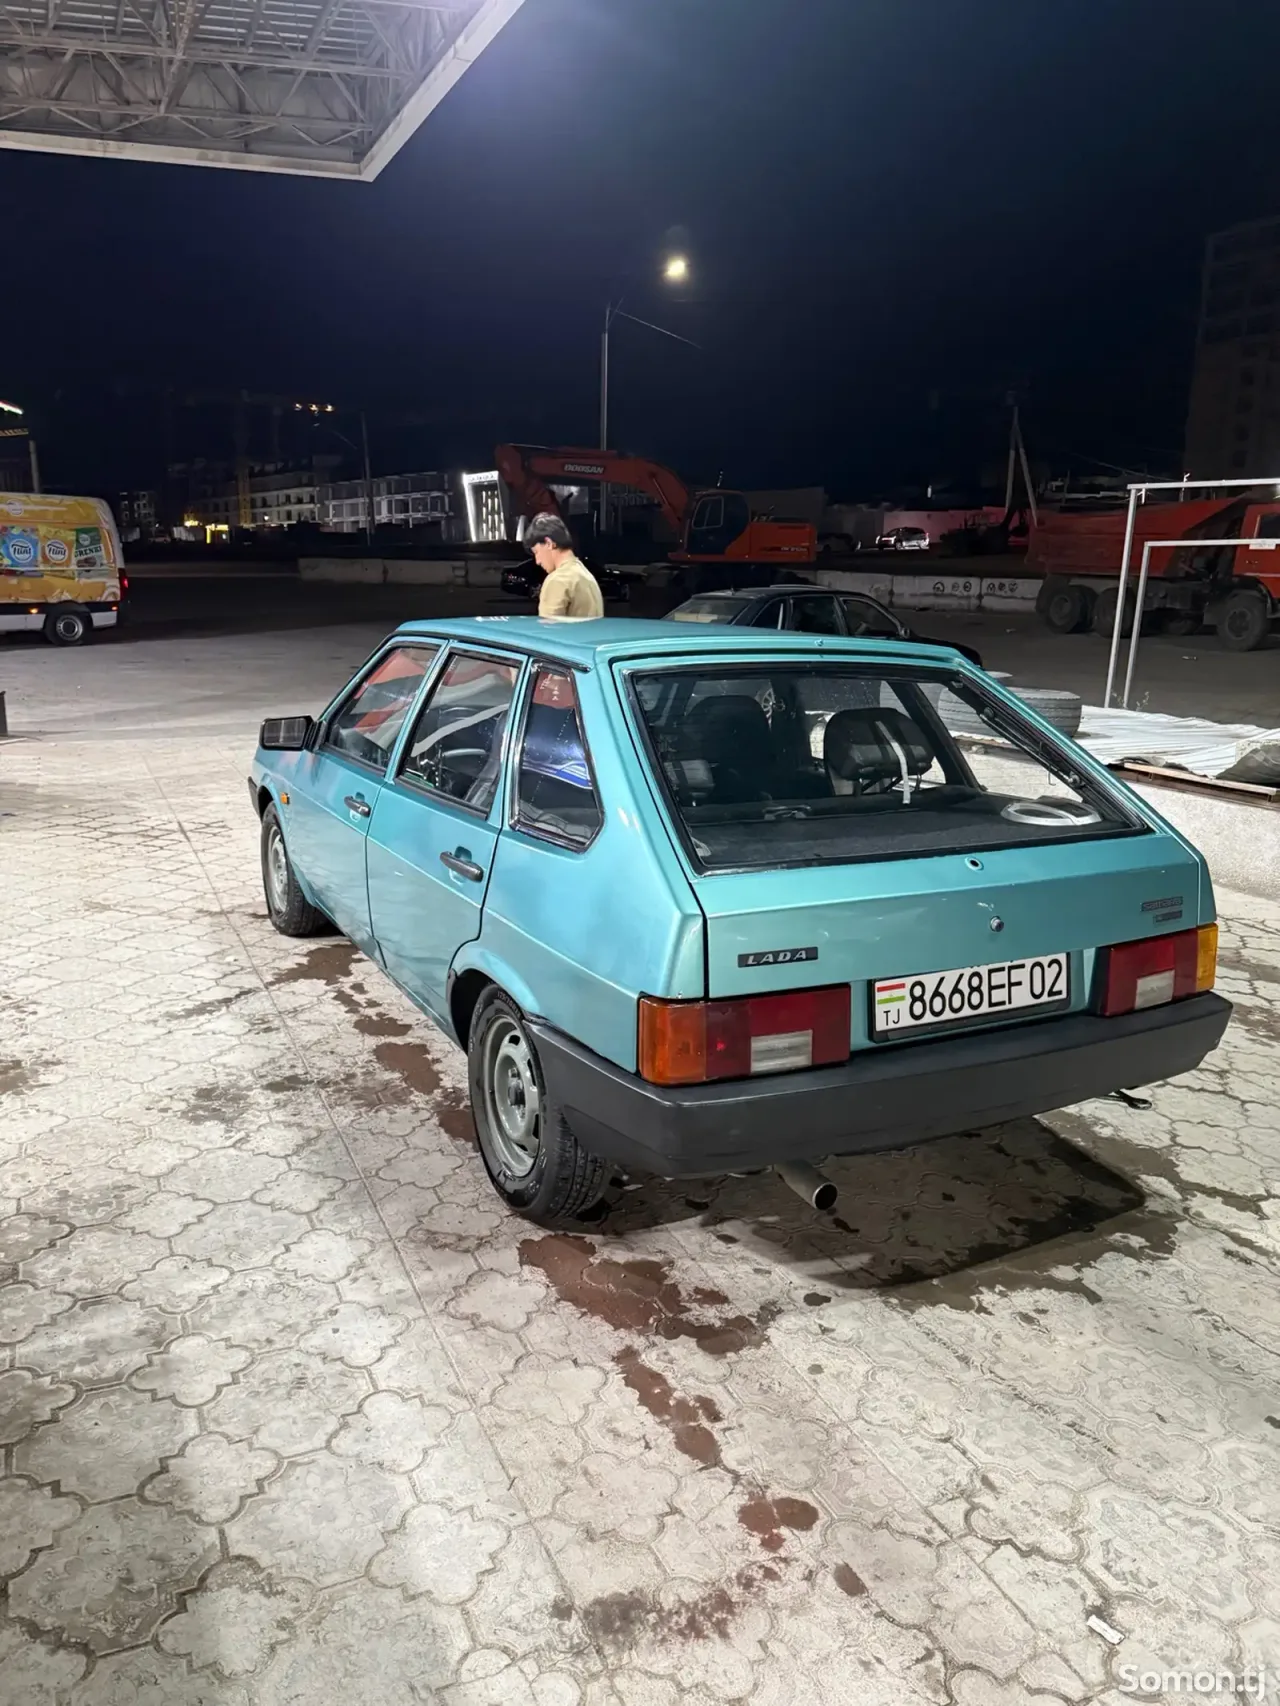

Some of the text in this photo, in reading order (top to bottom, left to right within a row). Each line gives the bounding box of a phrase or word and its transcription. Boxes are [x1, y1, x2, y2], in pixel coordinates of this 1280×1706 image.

[563, 463, 605, 474] DOOSAN
[747, 950, 807, 965] LADA
[909, 958, 1063, 1021] 8668EF02
[883, 1008, 901, 1026] TJ
